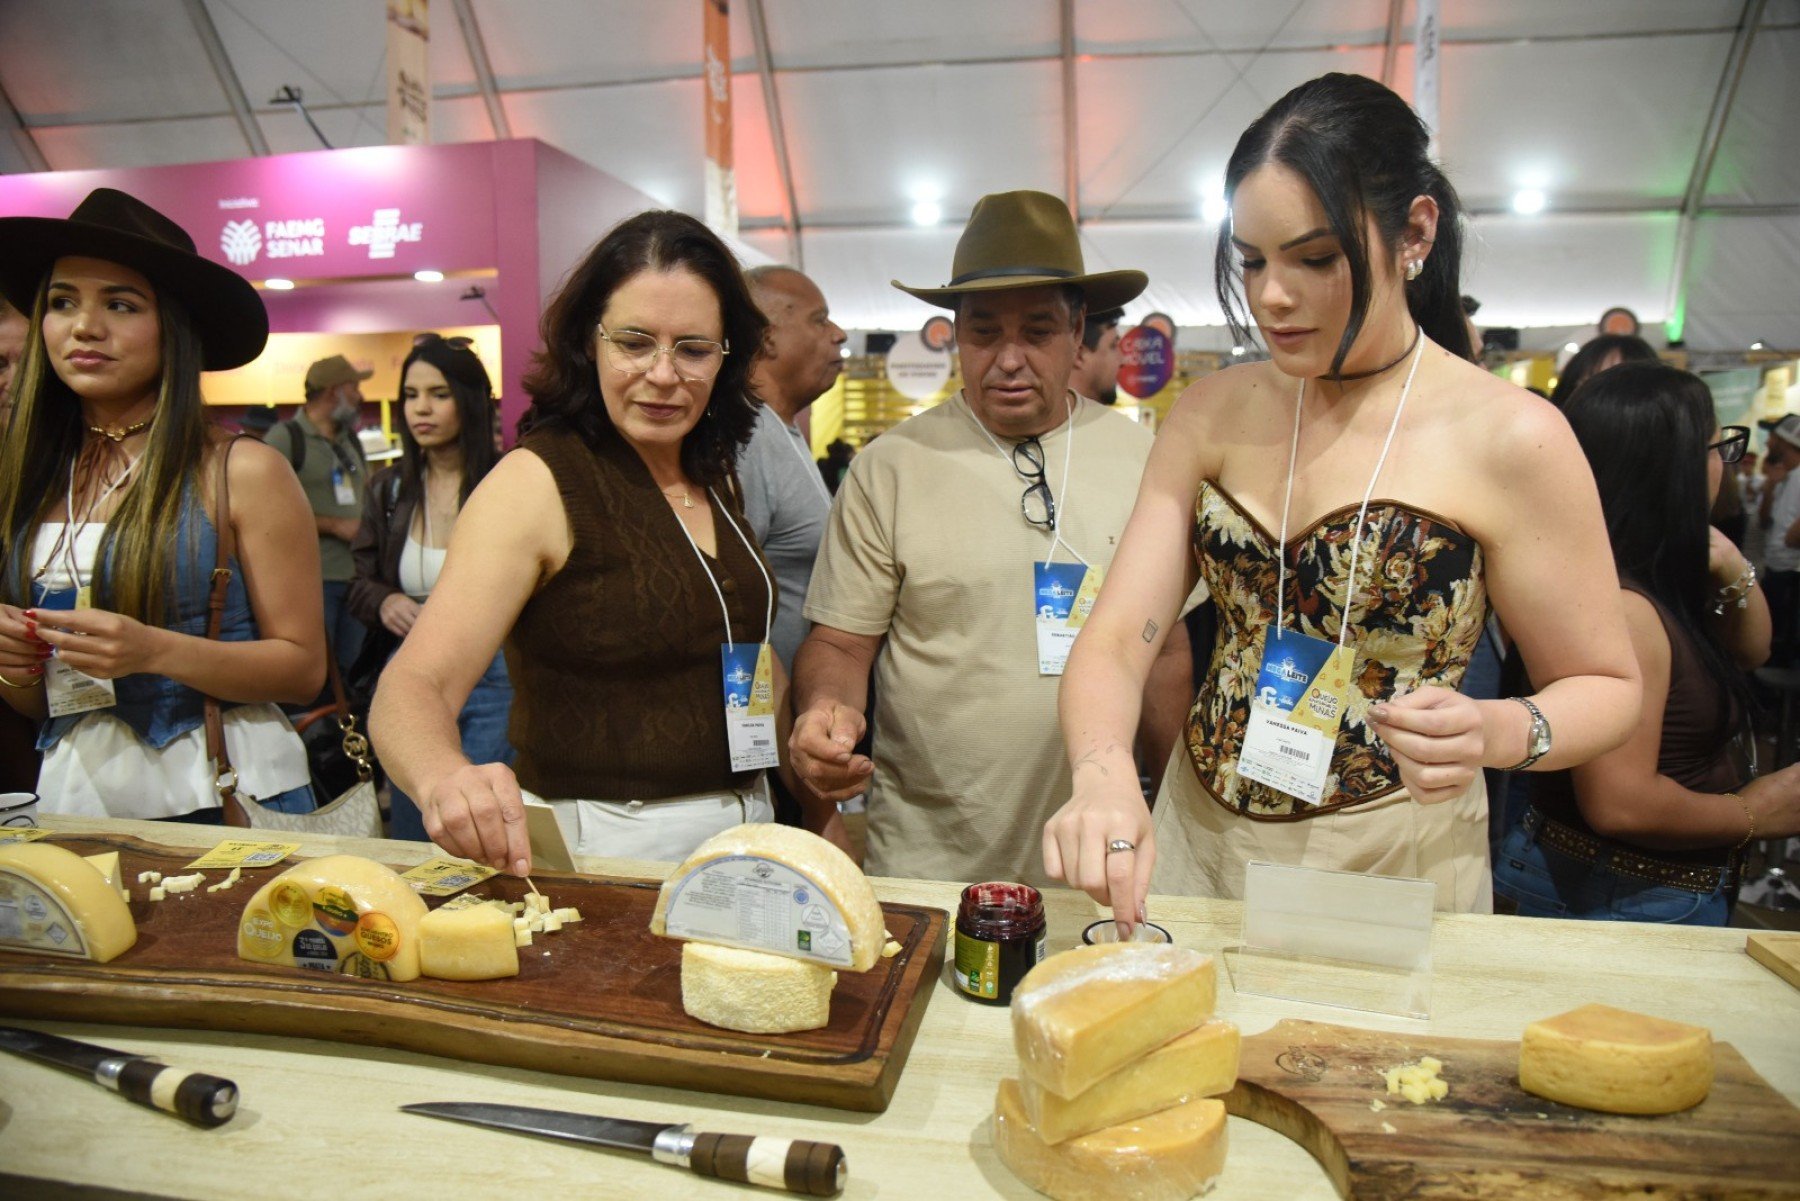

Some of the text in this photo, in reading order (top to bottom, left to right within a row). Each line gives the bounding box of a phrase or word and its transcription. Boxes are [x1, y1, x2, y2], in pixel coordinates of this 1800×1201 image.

[265, 218, 325, 239] FAEMG
[348, 221, 423, 246] SEBRAE
[265, 238, 325, 258] SENAR
[1265, 719, 1308, 736] VANESSA PAIVA
